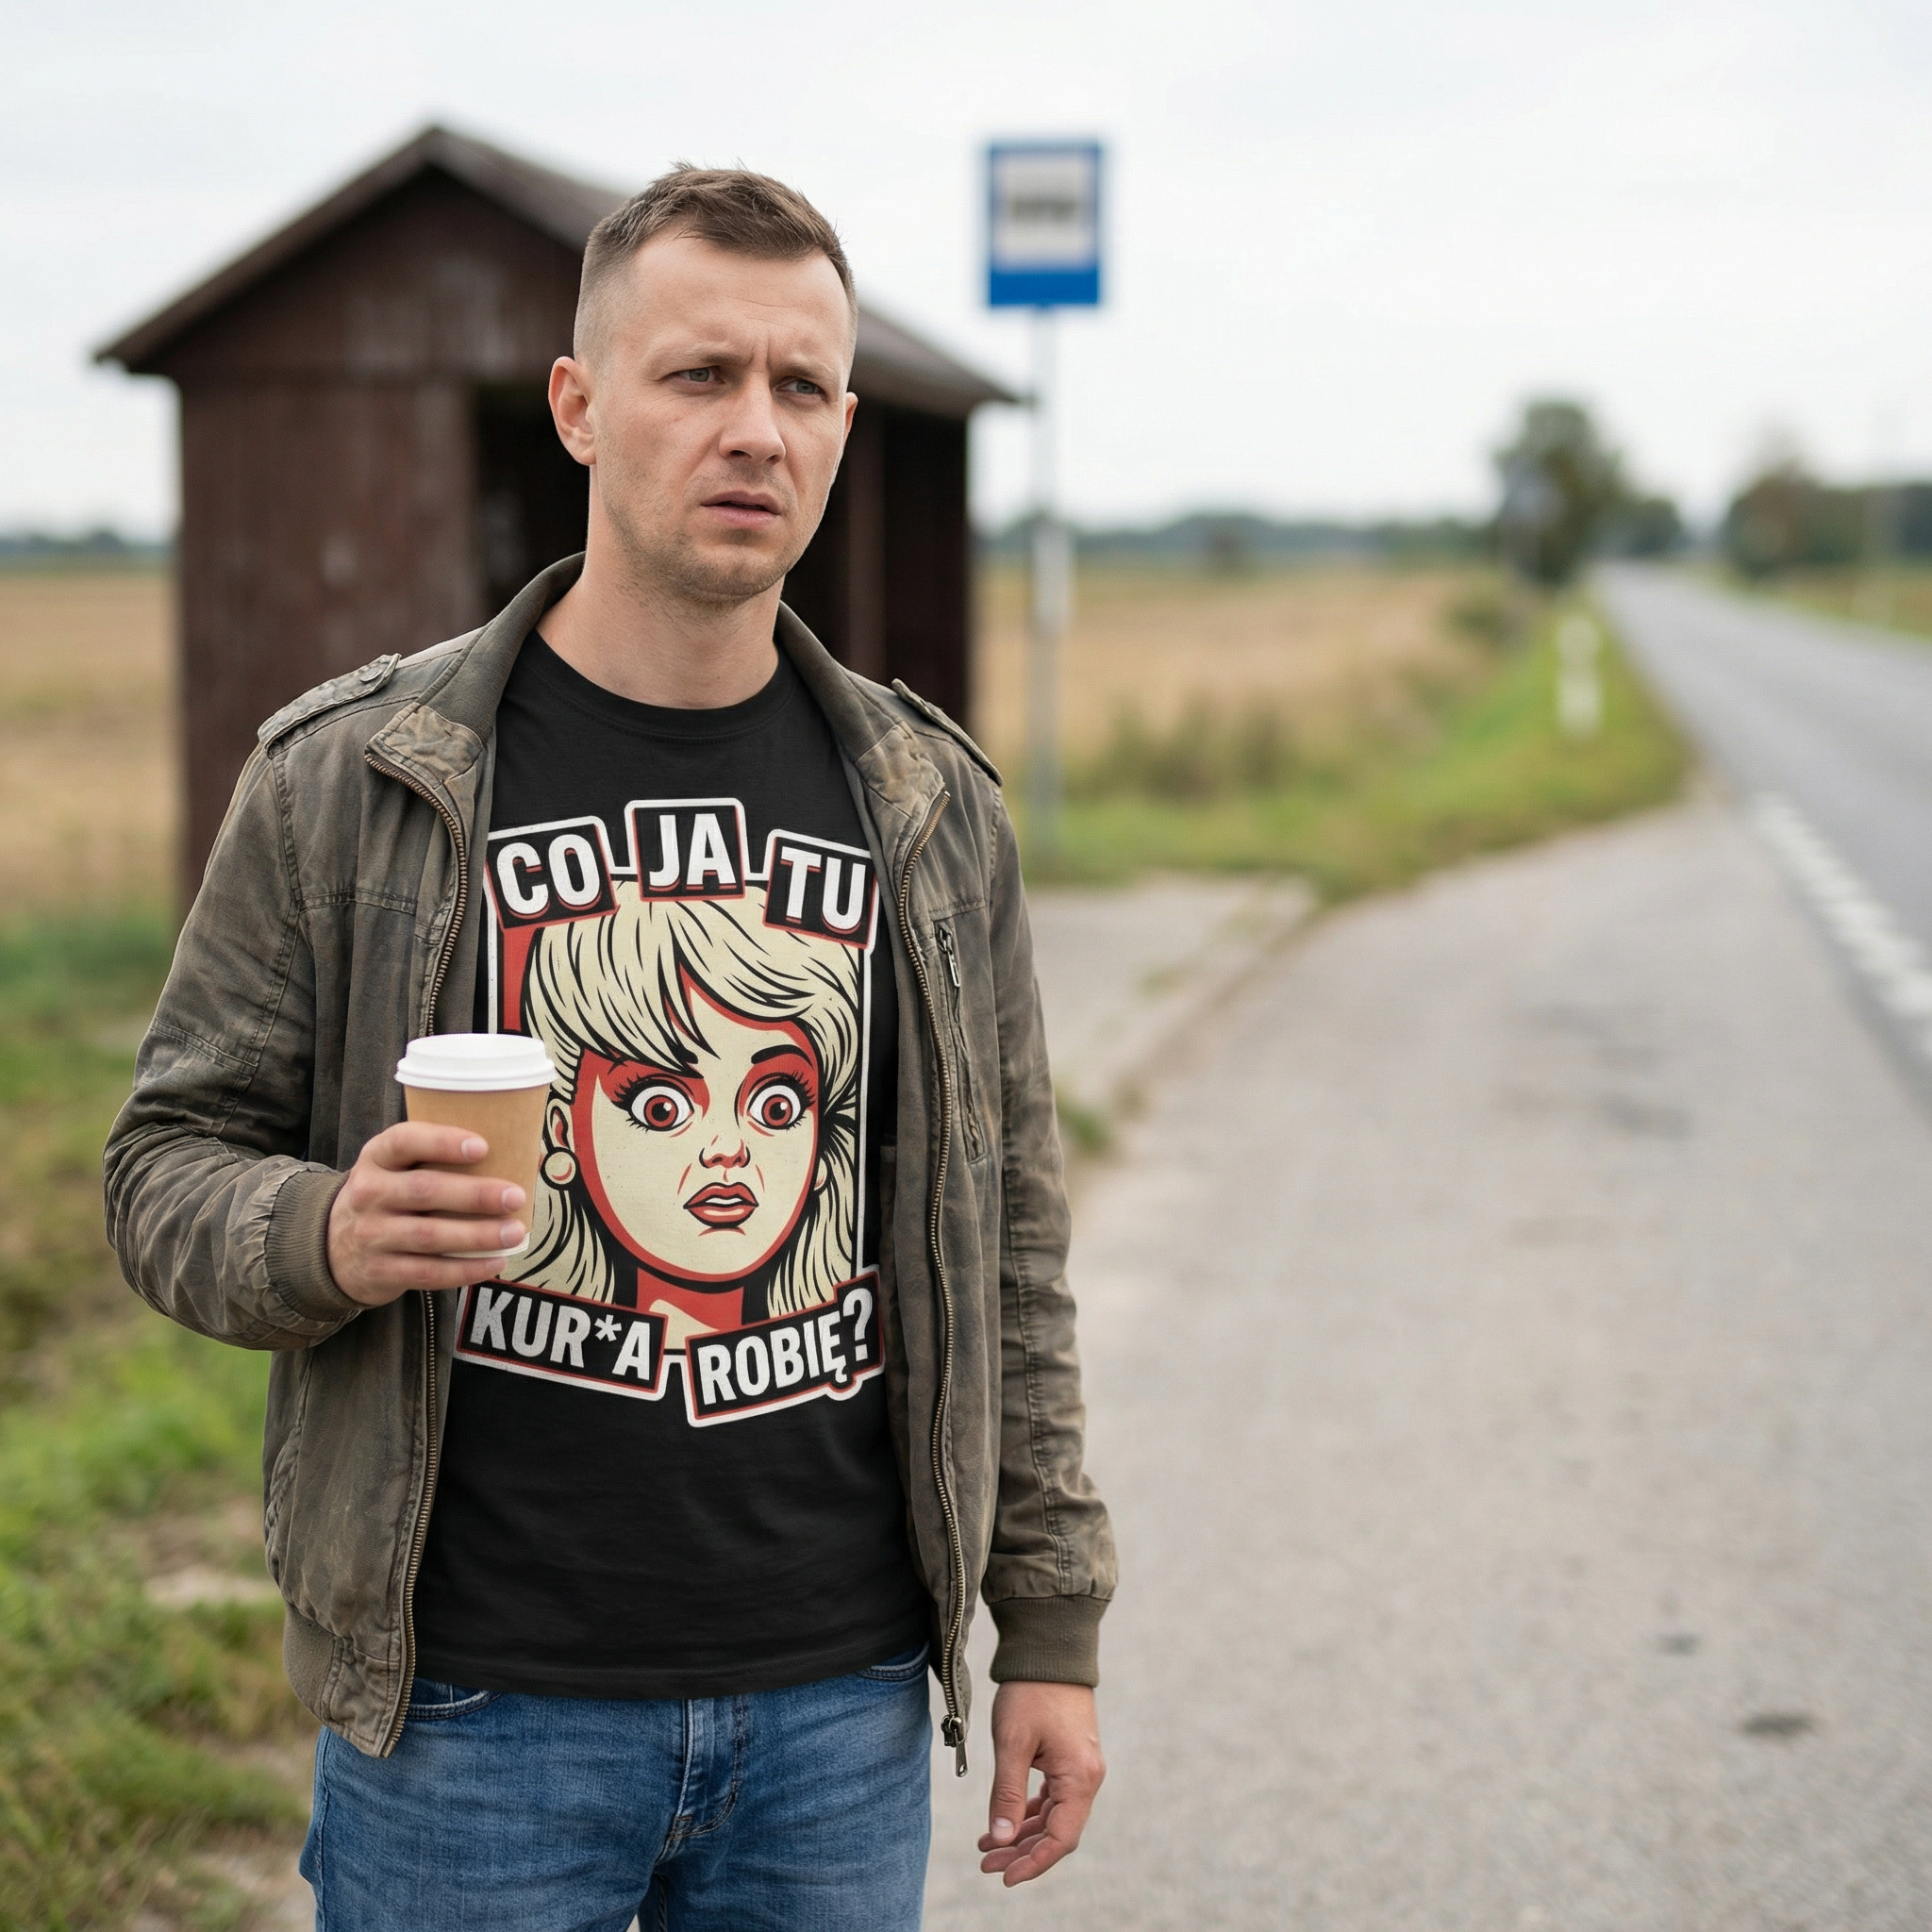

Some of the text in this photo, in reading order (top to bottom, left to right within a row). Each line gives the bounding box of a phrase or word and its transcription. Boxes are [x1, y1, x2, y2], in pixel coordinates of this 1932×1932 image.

[496, 812, 867, 931] CO JA TU
[696, 1287, 874, 1406] ROBIĘ?
